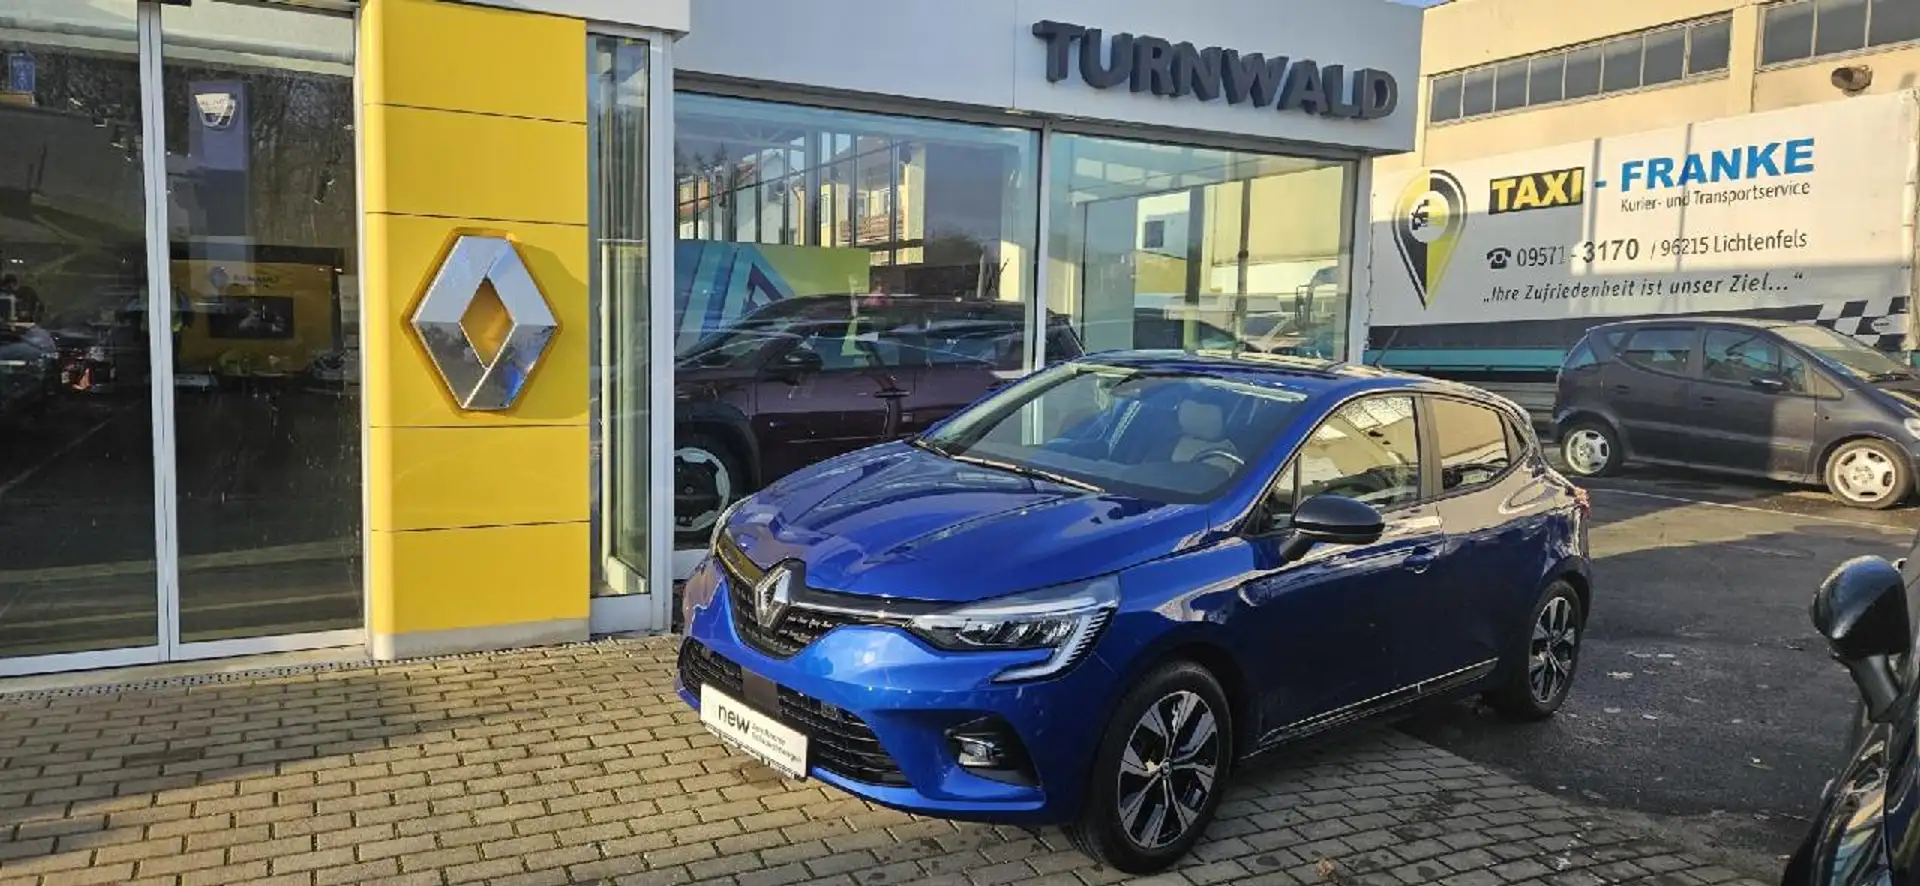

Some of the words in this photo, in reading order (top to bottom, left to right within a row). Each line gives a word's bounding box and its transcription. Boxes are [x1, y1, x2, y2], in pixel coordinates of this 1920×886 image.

[1032, 20, 1399, 119] TURNWALD
[1491, 169, 1583, 212] TAXI
[1621, 138, 1815, 192] FRANKE
[1621, 196, 1662, 213] Kurier-
[1666, 190, 1690, 209] und
[1694, 179, 1811, 206] Transportservice
[1582, 238, 1640, 263] 3170
[1660, 236, 1709, 256] 96215
[1714, 229, 1807, 253] Lichtenfels
[1524, 280, 1635, 303] Zufriedenheit
[1641, 278, 1662, 295] ist
[1669, 278, 1724, 294] unser
